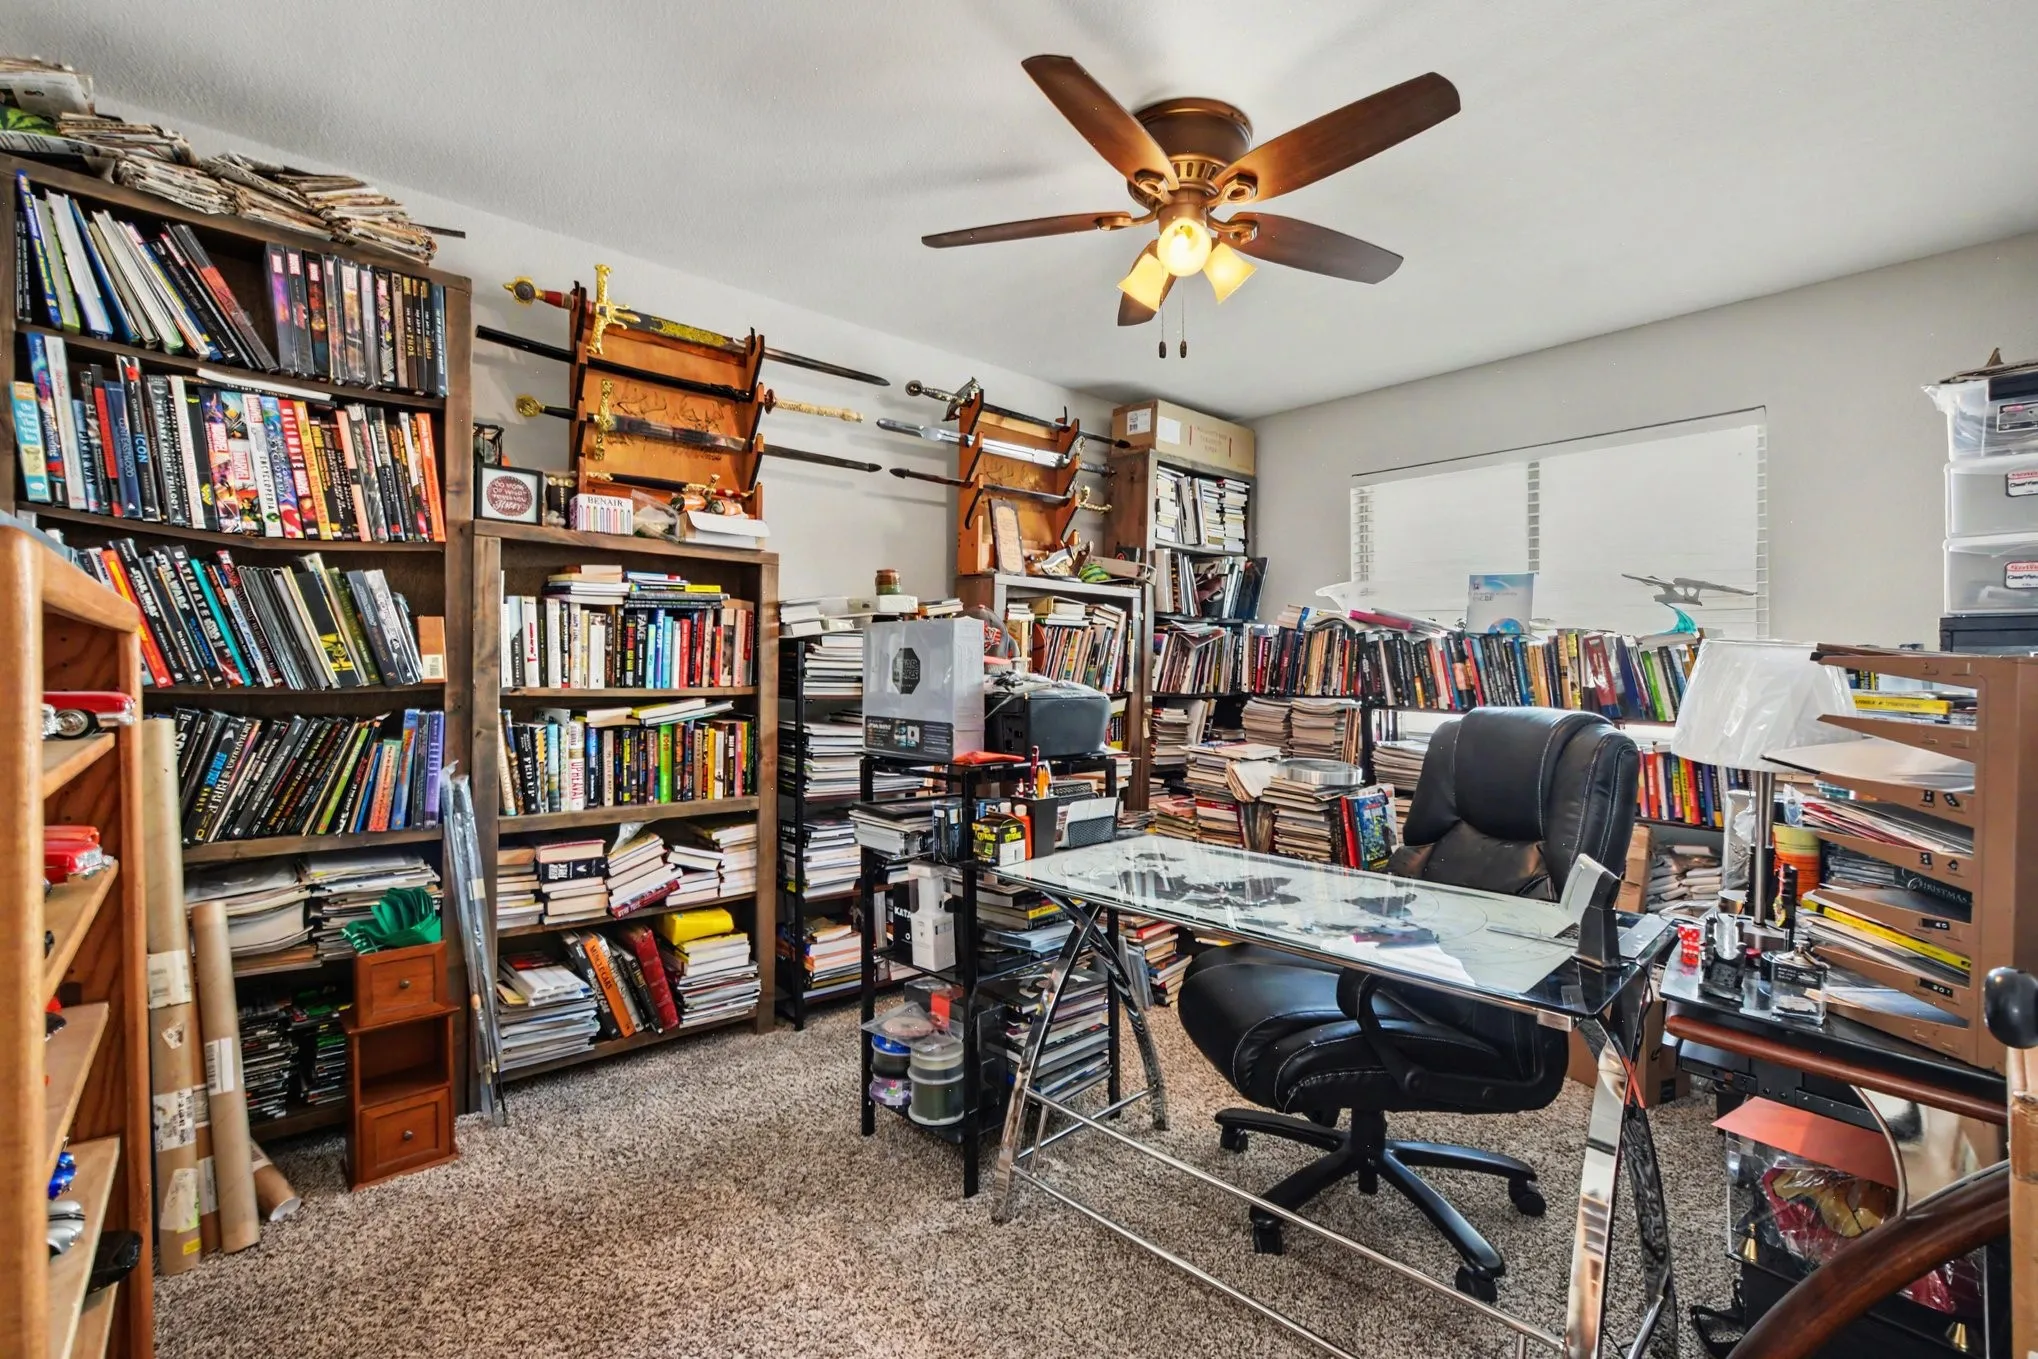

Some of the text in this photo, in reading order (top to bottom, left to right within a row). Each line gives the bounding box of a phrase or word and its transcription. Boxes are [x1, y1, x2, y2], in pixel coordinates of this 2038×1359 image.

[155, 399, 164, 415] THE
[134, 432, 148, 464] ICON
[281, 407, 305, 469] ULTIMATE
[162, 442, 173, 473] KNIGHT
[166, 475, 180, 511] TRILOGY
[259, 455, 275, 510] ENCYCLOPEDIA
[587, 496, 624, 507] BENAIR
[174, 550, 211, 618] ULTIMATE
[1908, 876, 1968, 903] CHRISTMAS
